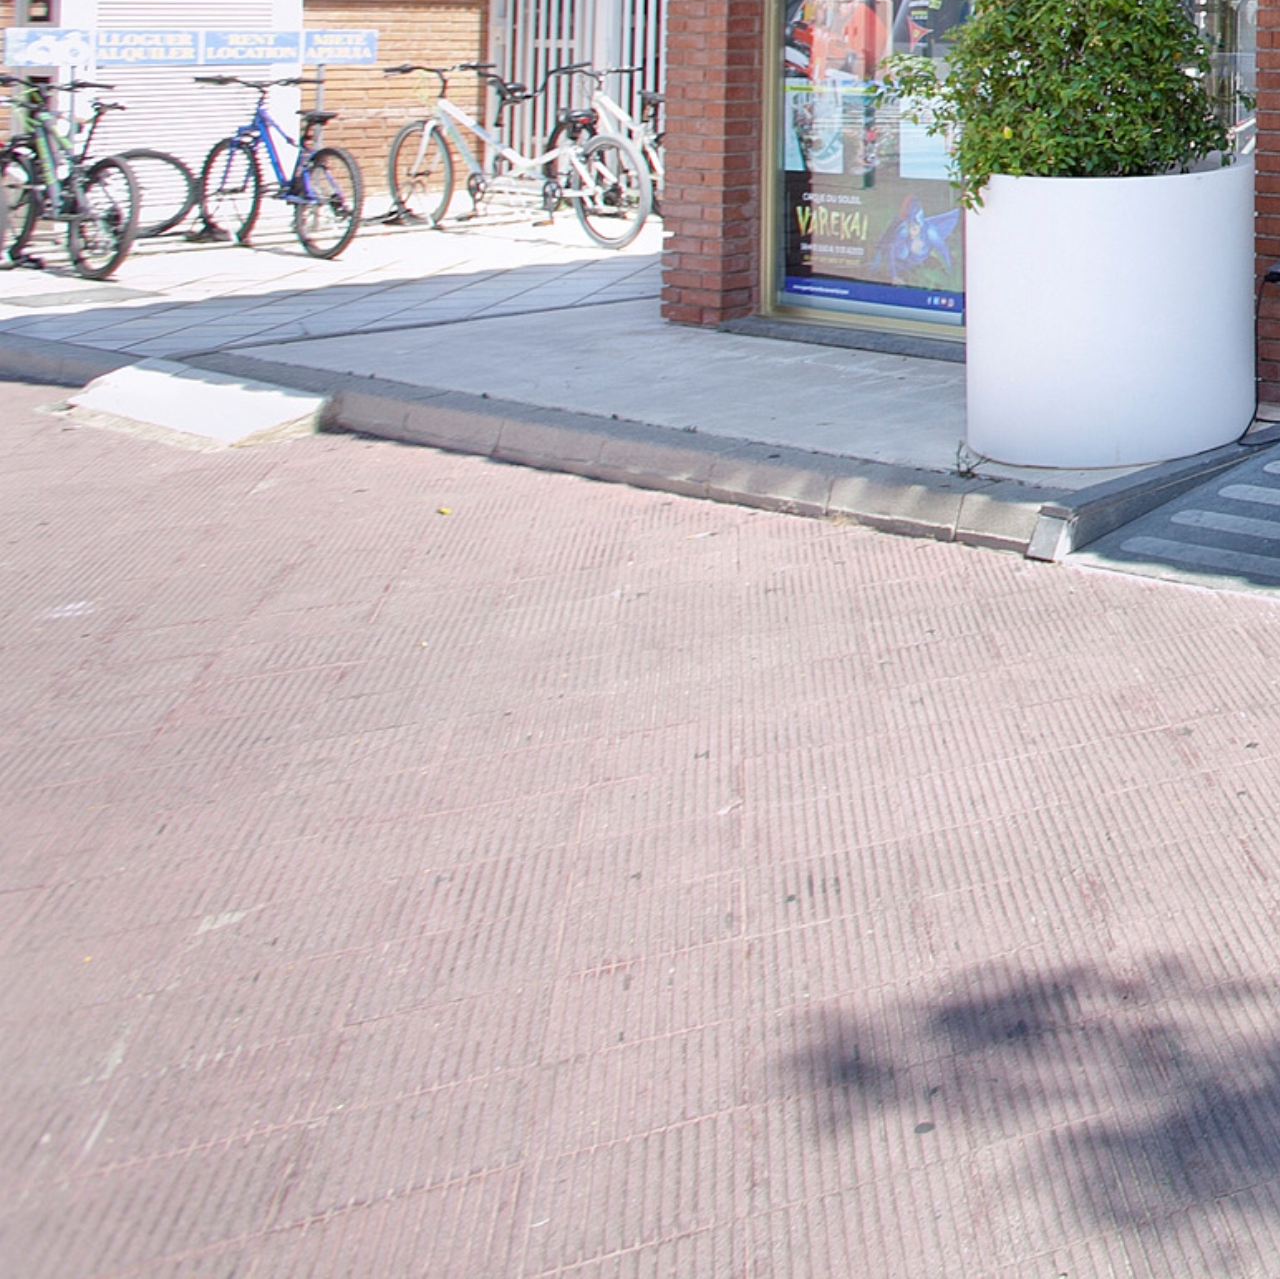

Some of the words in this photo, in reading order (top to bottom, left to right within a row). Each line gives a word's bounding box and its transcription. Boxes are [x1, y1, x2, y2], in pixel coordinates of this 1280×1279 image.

[100, 33, 194, 46] LLOGUER
[228, 34, 278, 46] RENT
[98, 47, 196, 61] ALQUILER
[206, 47, 297, 60] LOCATION
[795, 205, 869, 241] VAREKAI
